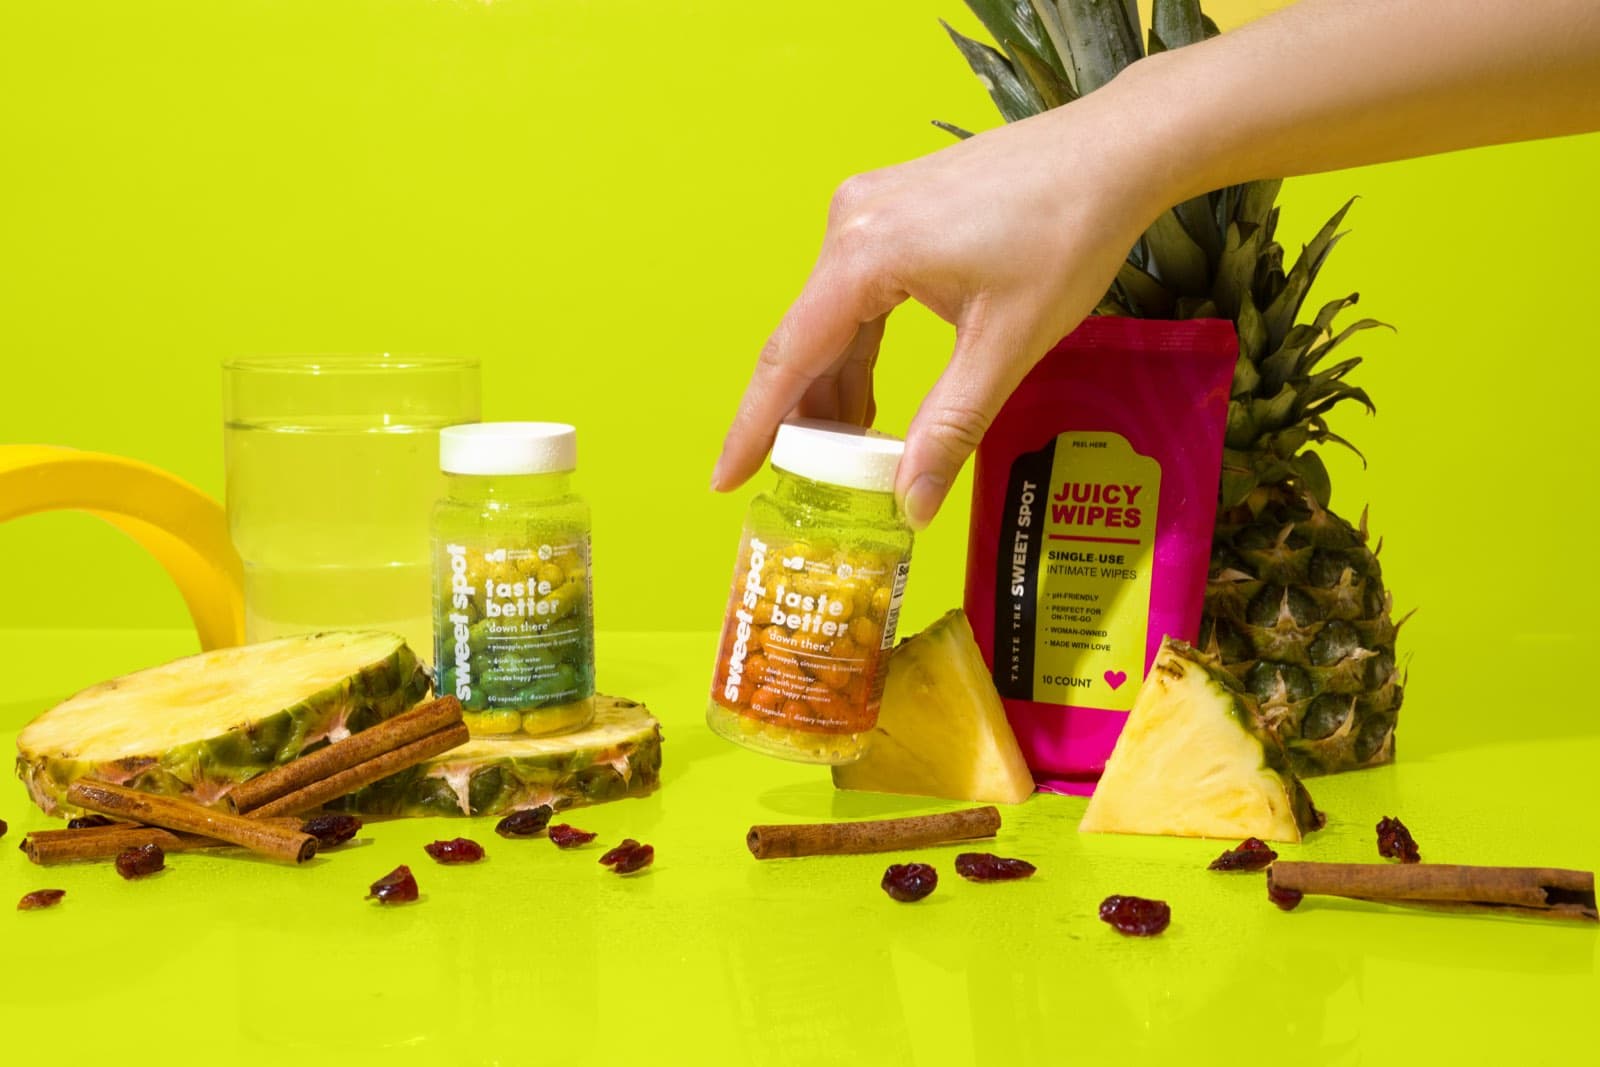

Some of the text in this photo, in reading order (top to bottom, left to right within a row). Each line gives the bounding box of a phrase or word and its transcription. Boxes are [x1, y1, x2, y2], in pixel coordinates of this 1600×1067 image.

[1054, 482, 1142, 505] JUICY
[1018, 480, 1037, 527] SPOT
[1051, 504, 1141, 528] WIPES
[1011, 531, 1029, 597] SWEET
[1048, 551, 1125, 564] SINGLE-USE
[1047, 565, 1137, 579] INTIMATE WIPES
[485, 577, 552, 598] taste
[486, 597, 560, 617] better
[775, 584, 844, 616] taste
[1013, 603, 1022, 630] THE
[1051, 614, 1091, 622] ON-THE-GO
[1052, 606, 1084, 614] PERFECT
[447, 544, 476, 701] sweet spot
[724, 538, 768, 703] sweet spot
[771, 604, 848, 638] better
[1050, 627, 1107, 637] WOMAN-OWNED
[1050, 640, 1070, 648] MADE
[1091, 643, 1111, 651] LOVE
[776, 679, 790, 688] with
[790, 682, 805, 691] your
[782, 671, 797, 680] your
[797, 674, 817, 683] water
[1042, 675, 1092, 688] 10 COUNT
[781, 688, 801, 700] happy
[751, 703, 762, 711] 60
